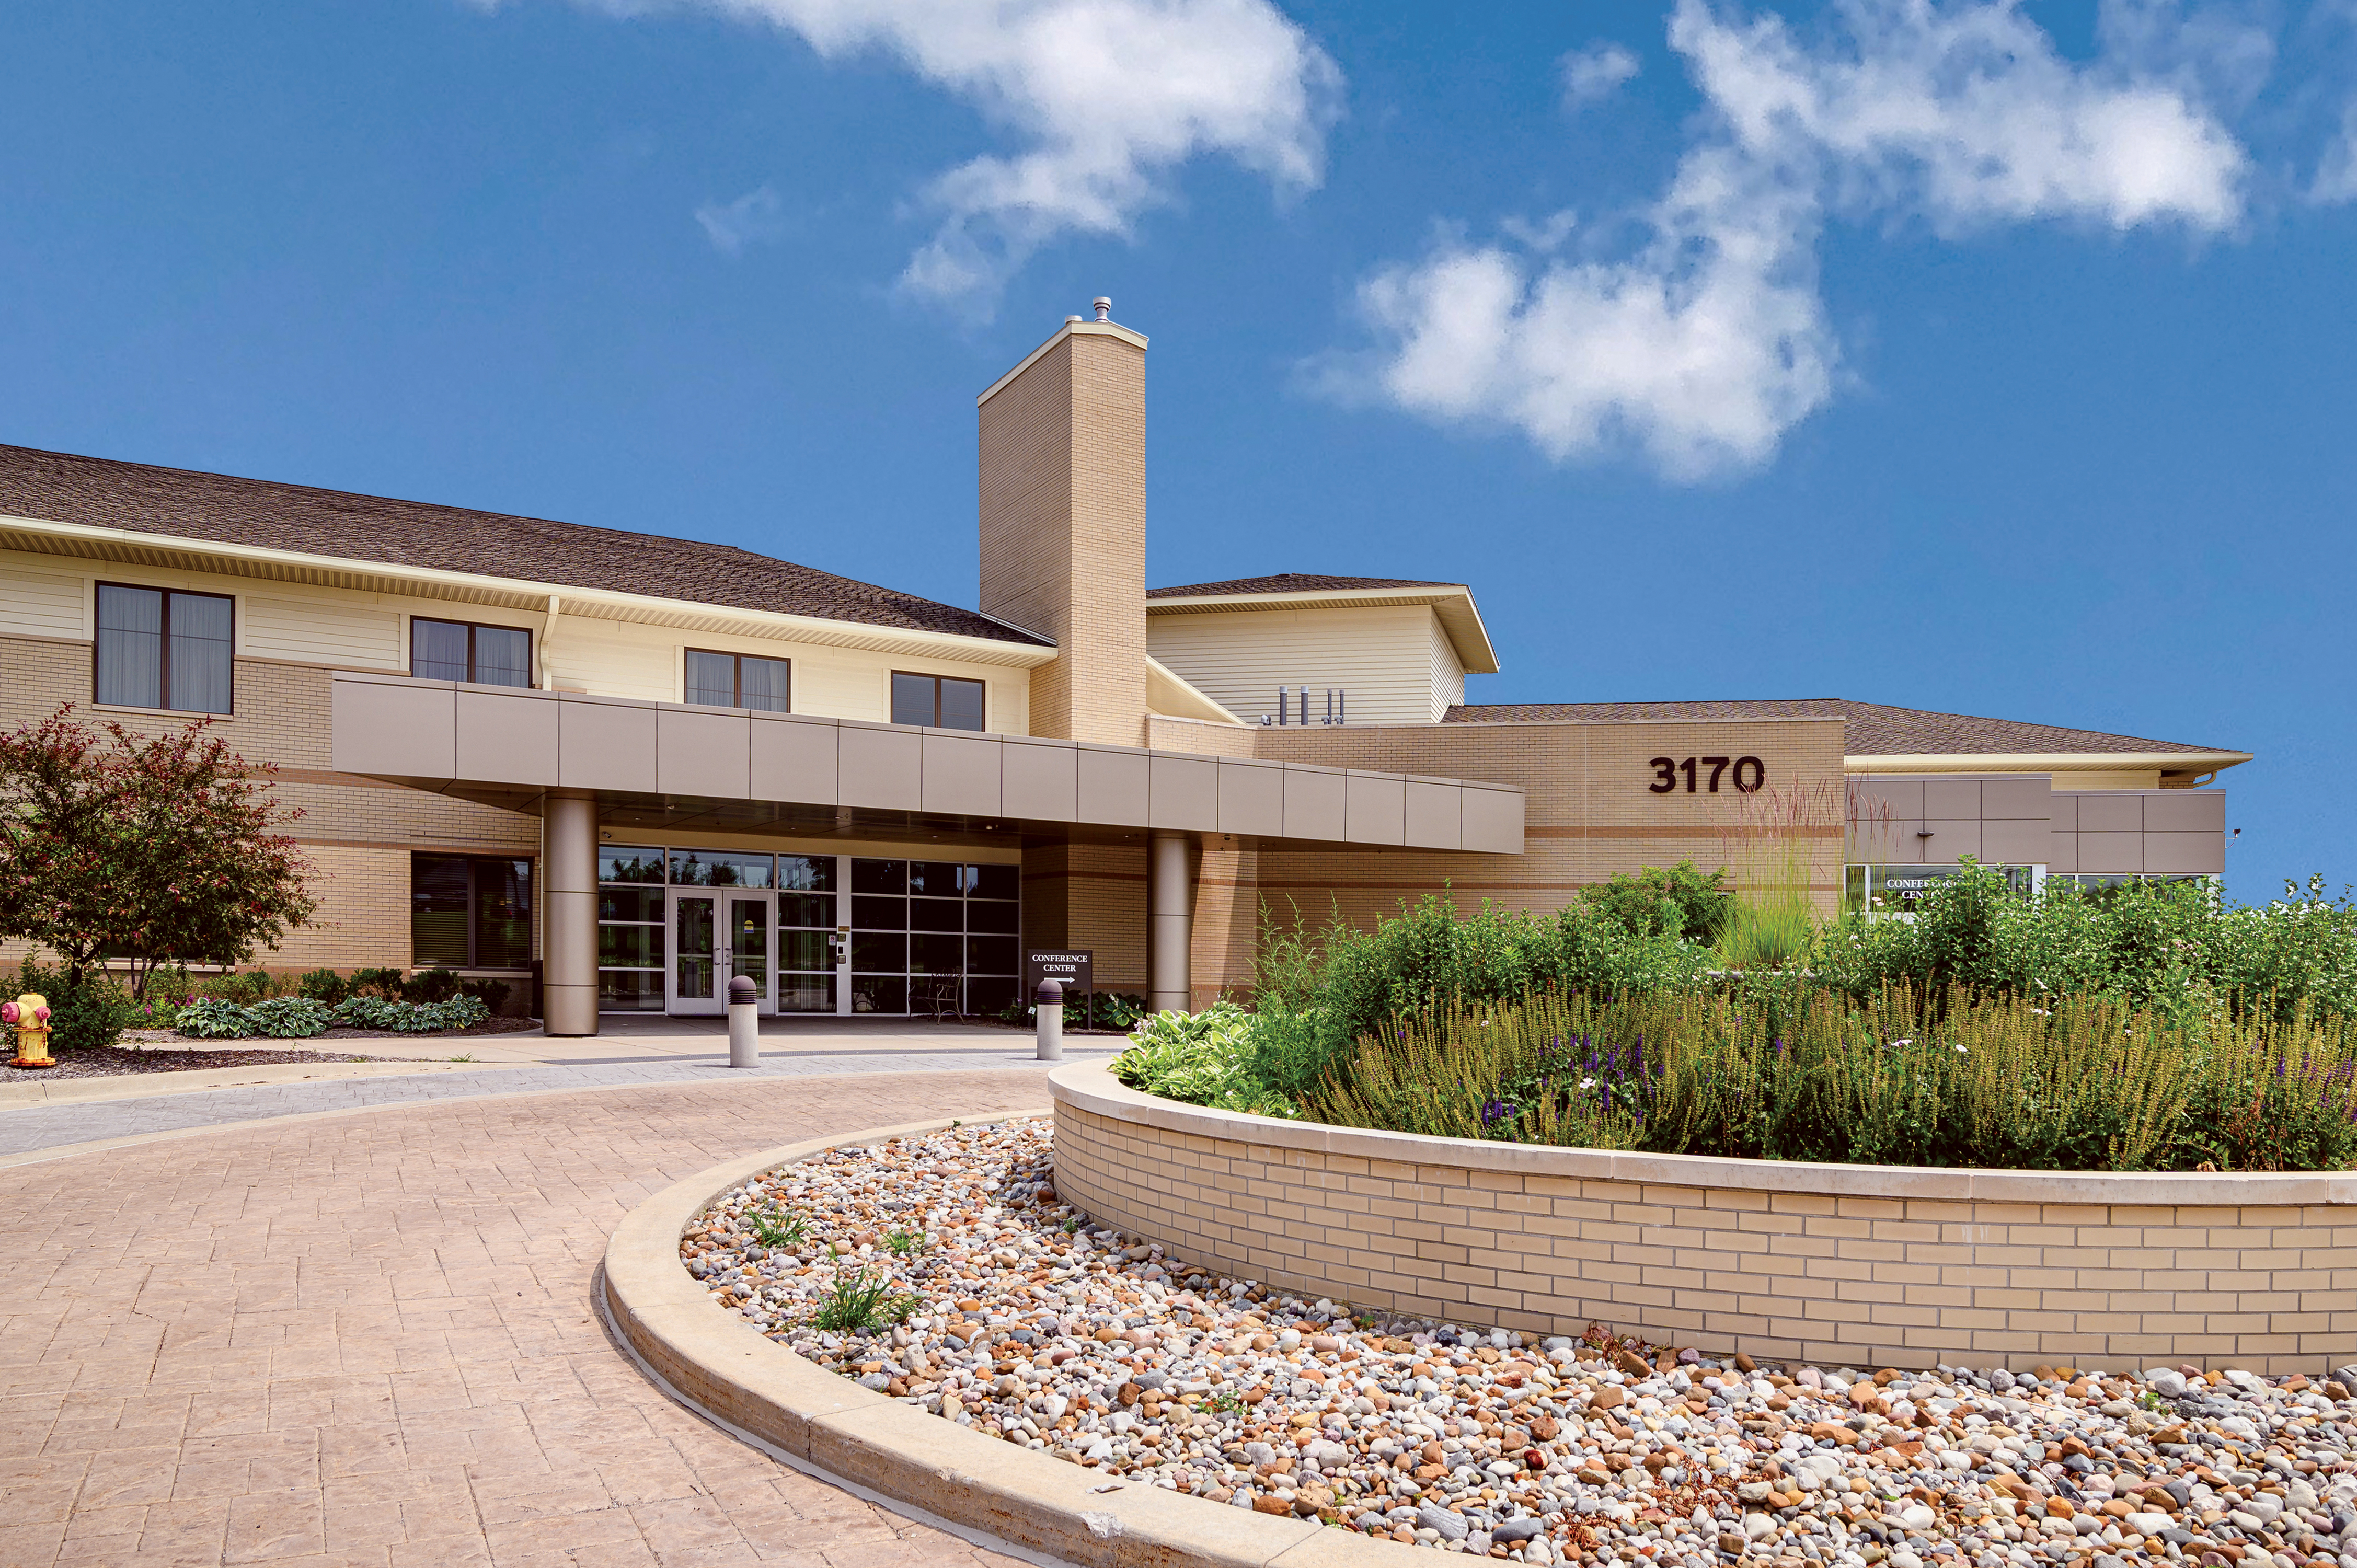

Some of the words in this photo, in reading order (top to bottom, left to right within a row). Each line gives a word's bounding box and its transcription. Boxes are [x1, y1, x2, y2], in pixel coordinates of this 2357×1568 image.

[1649, 756, 1765, 793] 3170
[1887, 879, 1960, 888] CONFERC
[1043, 964, 1076, 972] CENTER
